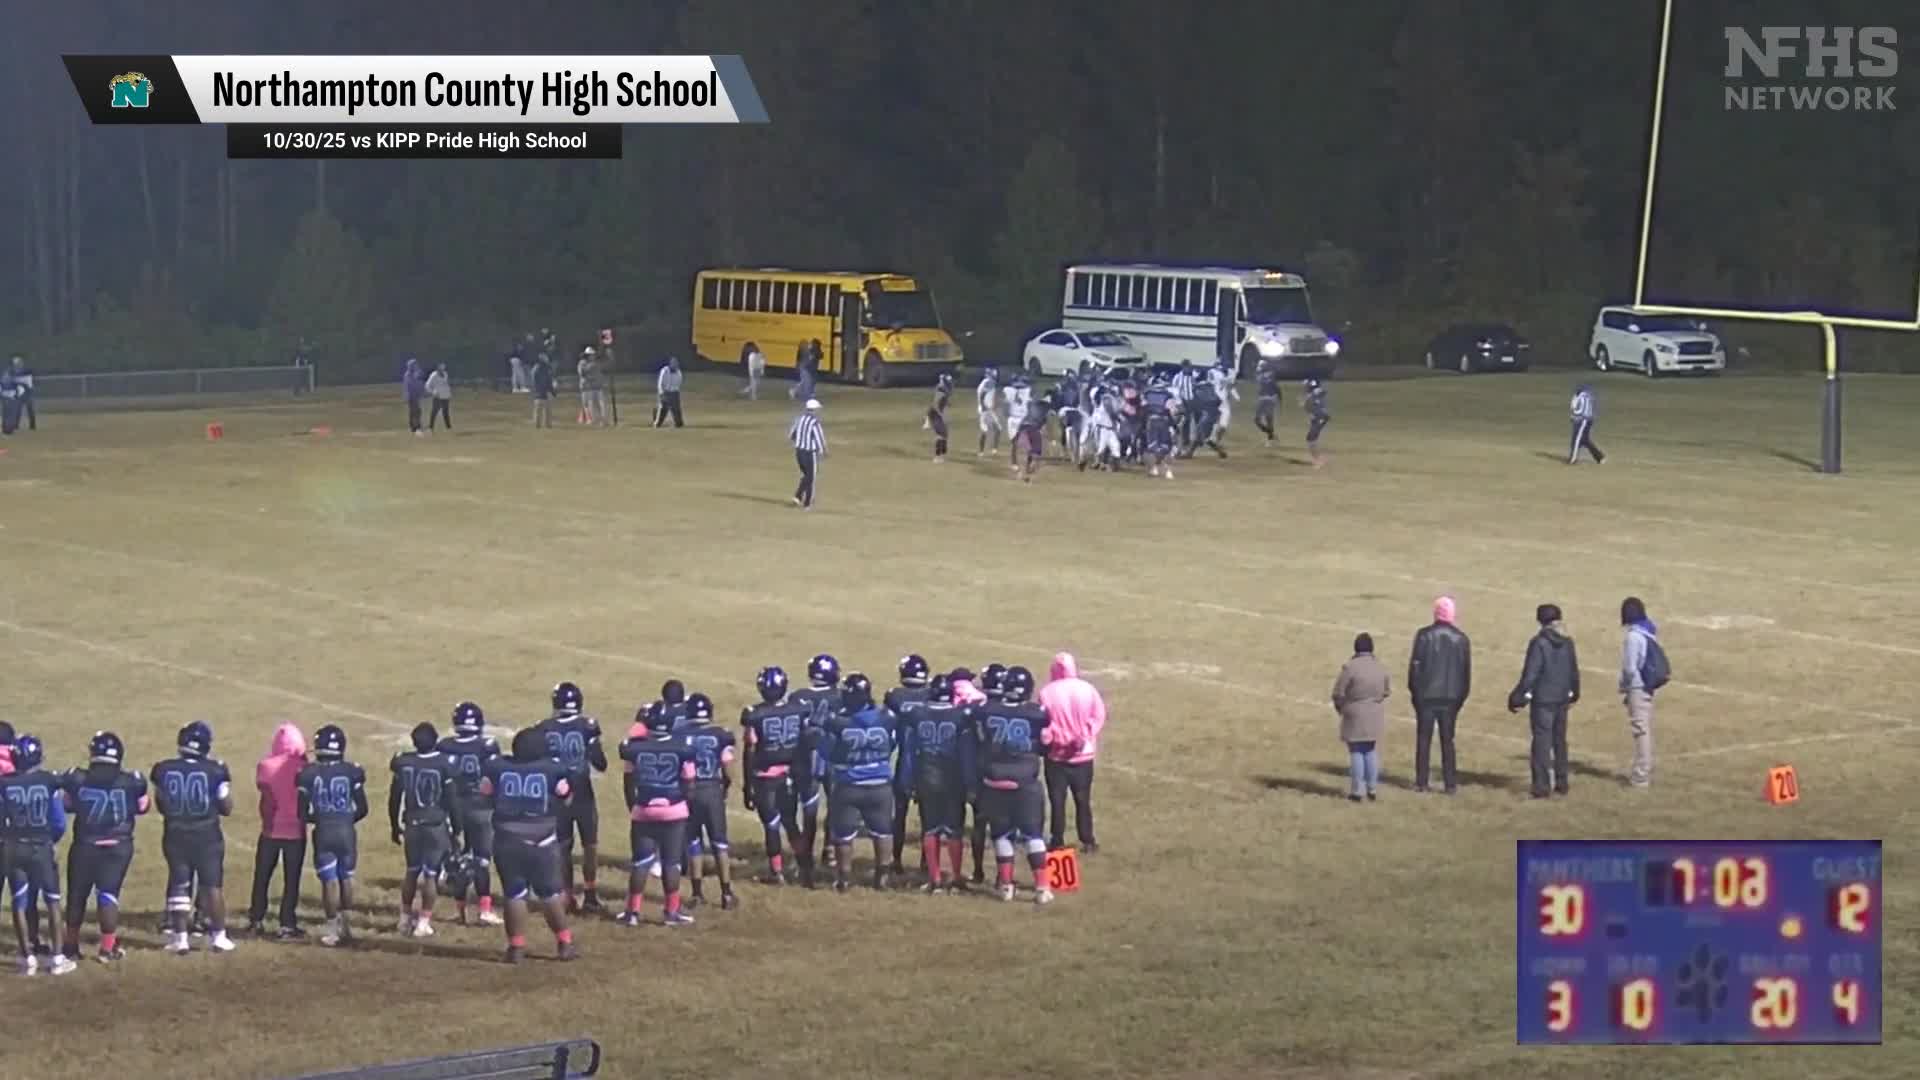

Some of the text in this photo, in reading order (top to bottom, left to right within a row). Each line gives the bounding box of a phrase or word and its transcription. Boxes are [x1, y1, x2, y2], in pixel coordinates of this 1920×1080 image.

[1775, 771, 1796, 800] 20
[79, 787, 128, 825] 71
[1047, 855, 1076, 889] 30
